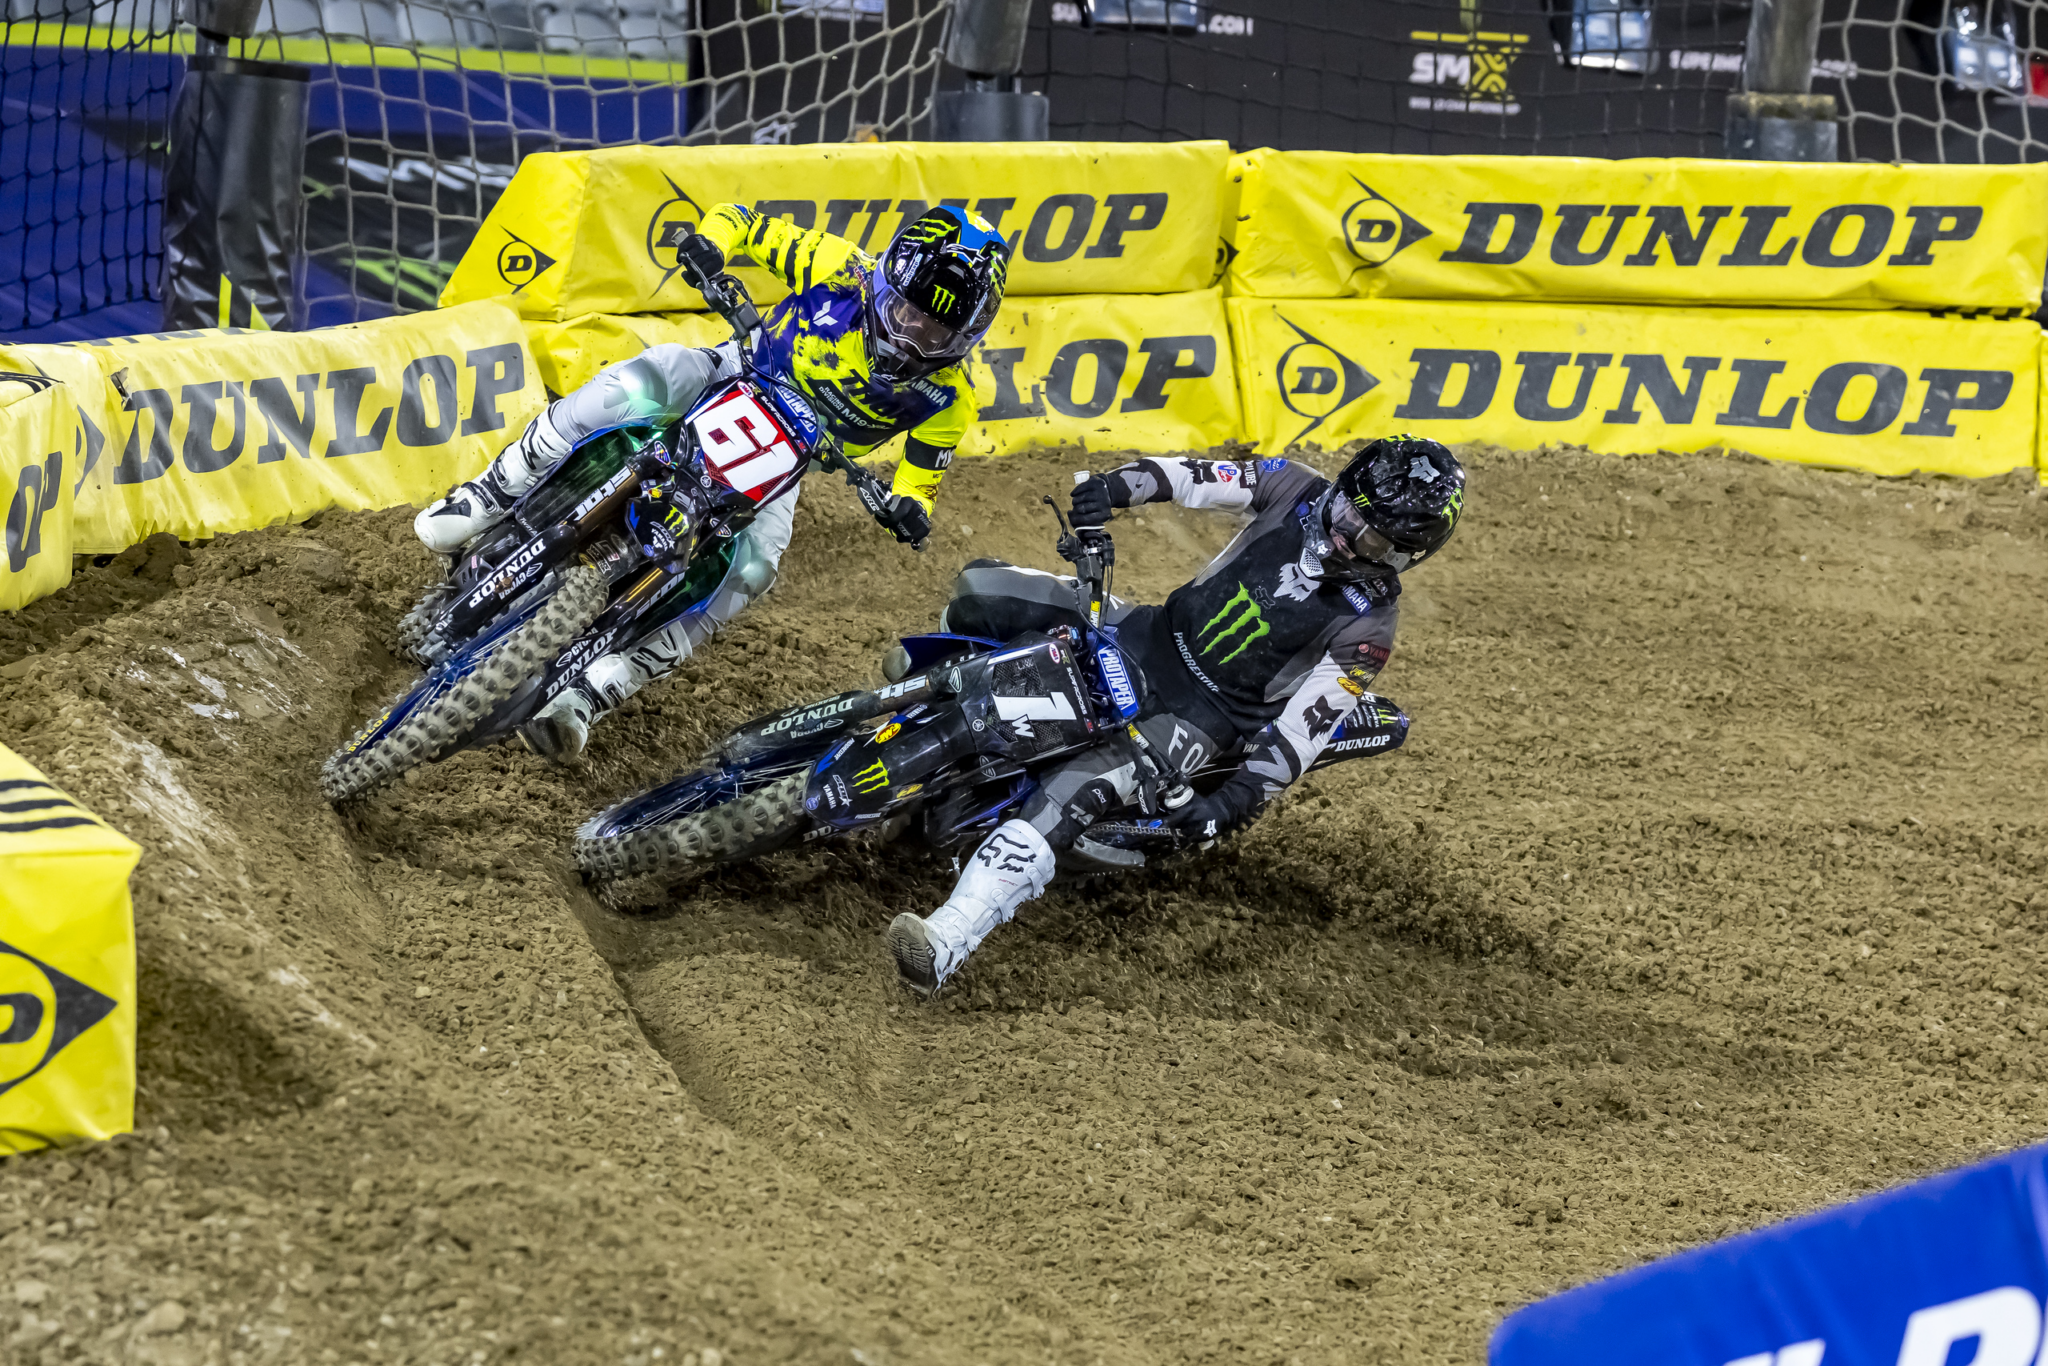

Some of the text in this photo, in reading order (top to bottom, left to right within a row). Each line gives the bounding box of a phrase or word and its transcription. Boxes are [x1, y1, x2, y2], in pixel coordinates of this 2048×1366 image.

[1355, 219, 1396, 243] D
[1440, 202, 1983, 268] DUNLOP
[506, 255, 533, 273] D
[976, 334, 1217, 422] LOP
[1290, 366, 1338, 395] D
[1394, 348, 2014, 437] DUNLOP
[114, 342, 525, 485] DUNLOP
[693, 394, 798, 493] 61
[469, 537, 547, 609] DUNLOP
[546, 627, 618, 701] DUNLOP
[1101, 646, 1136, 708] PROTAPER
[348, 711, 391, 753] DUNLOP
[760, 697, 855, 737] DUNLOP
[992, 691, 1077, 721] 1
[1334, 735, 1391, 752] DUNLOP
[822, 783, 837, 810] YAMAHA
